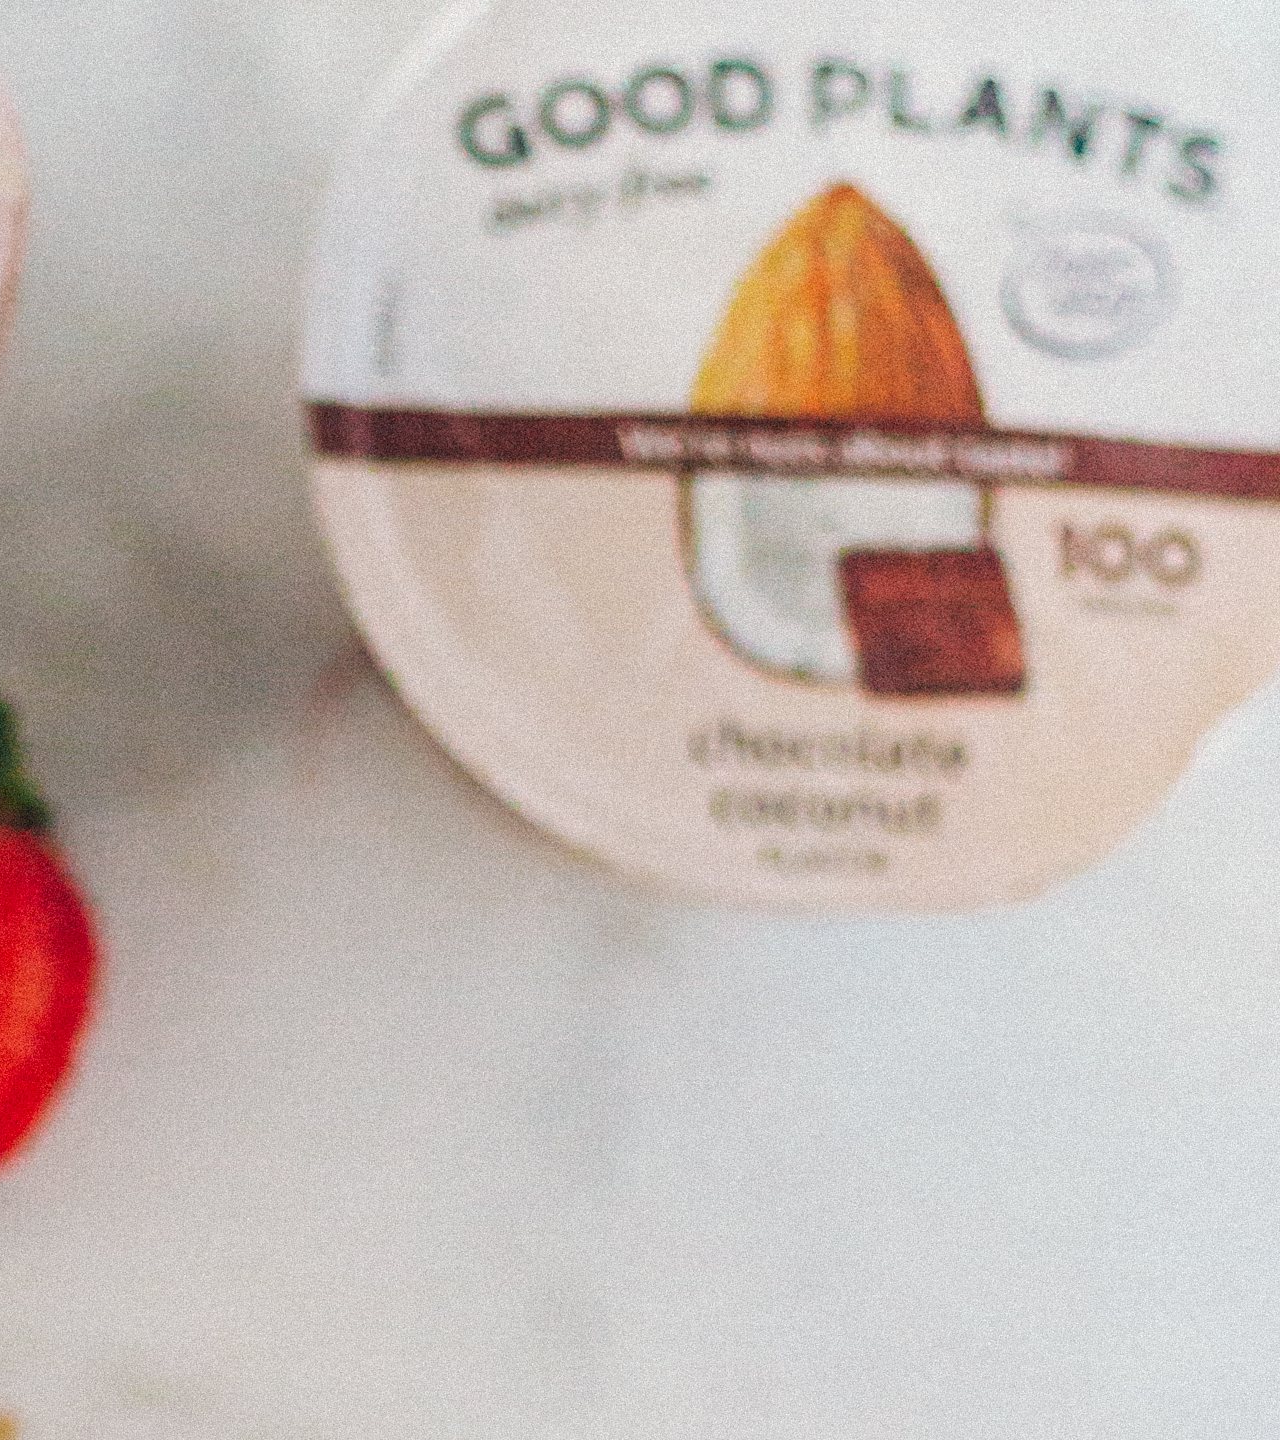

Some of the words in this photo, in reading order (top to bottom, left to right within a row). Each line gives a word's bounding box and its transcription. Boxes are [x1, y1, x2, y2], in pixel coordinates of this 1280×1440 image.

[458, 58, 772, 168] GOOD
[814, 60, 1225, 205] PLANTS
[1059, 520, 1199, 590] 100
